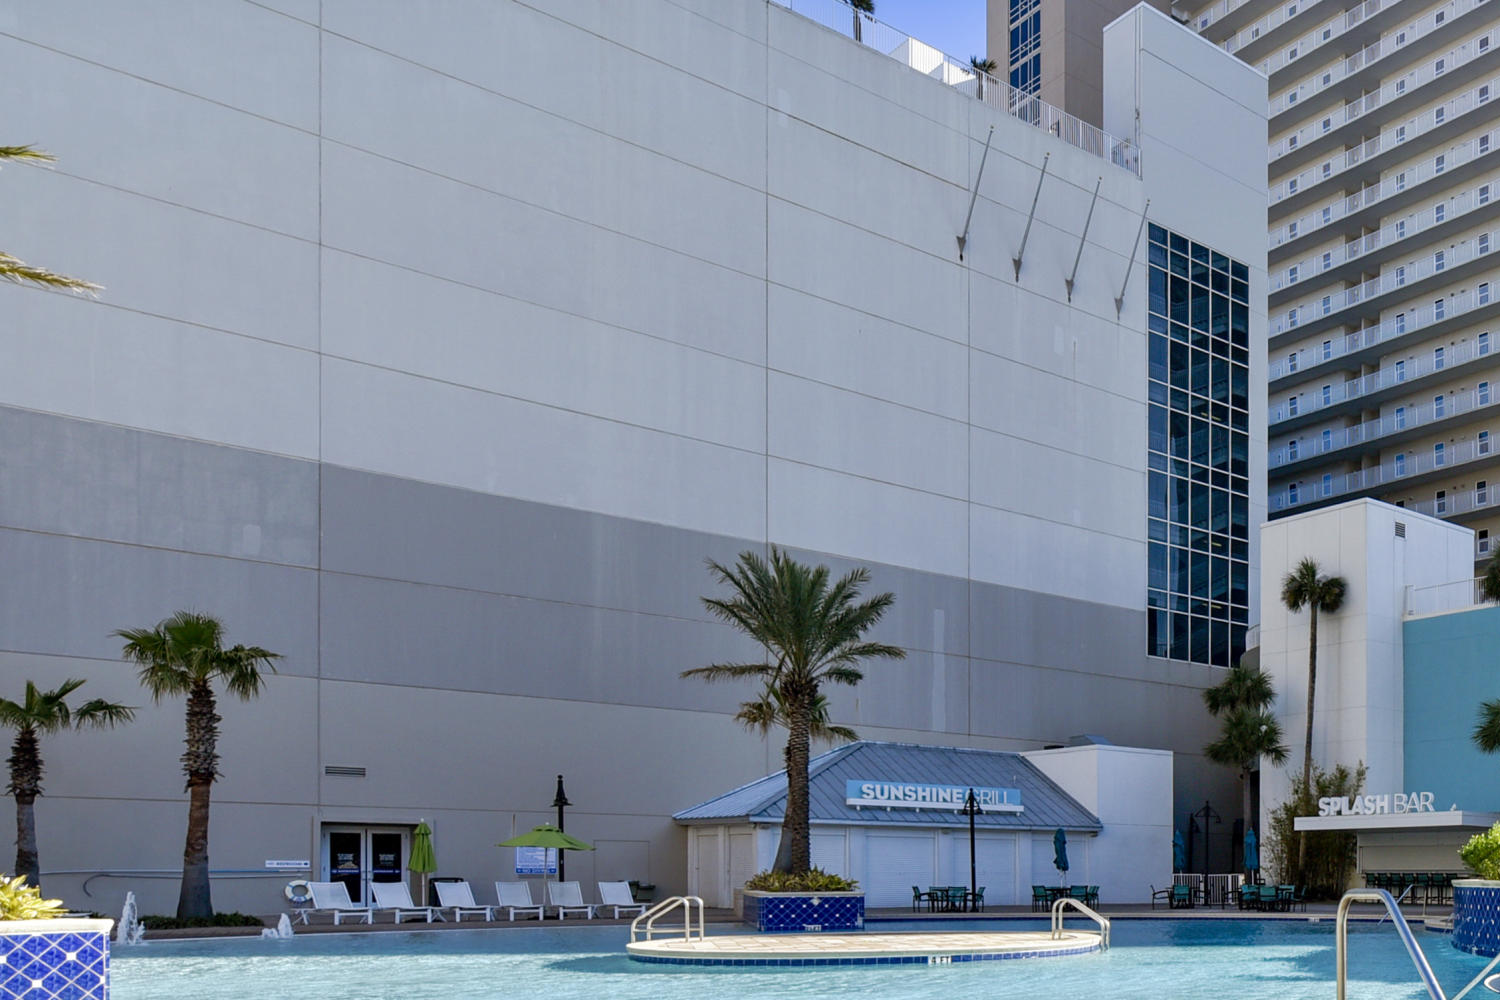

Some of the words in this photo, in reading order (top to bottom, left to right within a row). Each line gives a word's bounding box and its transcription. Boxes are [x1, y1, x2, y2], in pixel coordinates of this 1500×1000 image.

[861, 783, 963, 803] SUNSHINE
[1318, 795, 1388, 817] SPLASH
[1393, 791, 1435, 814] BAR
